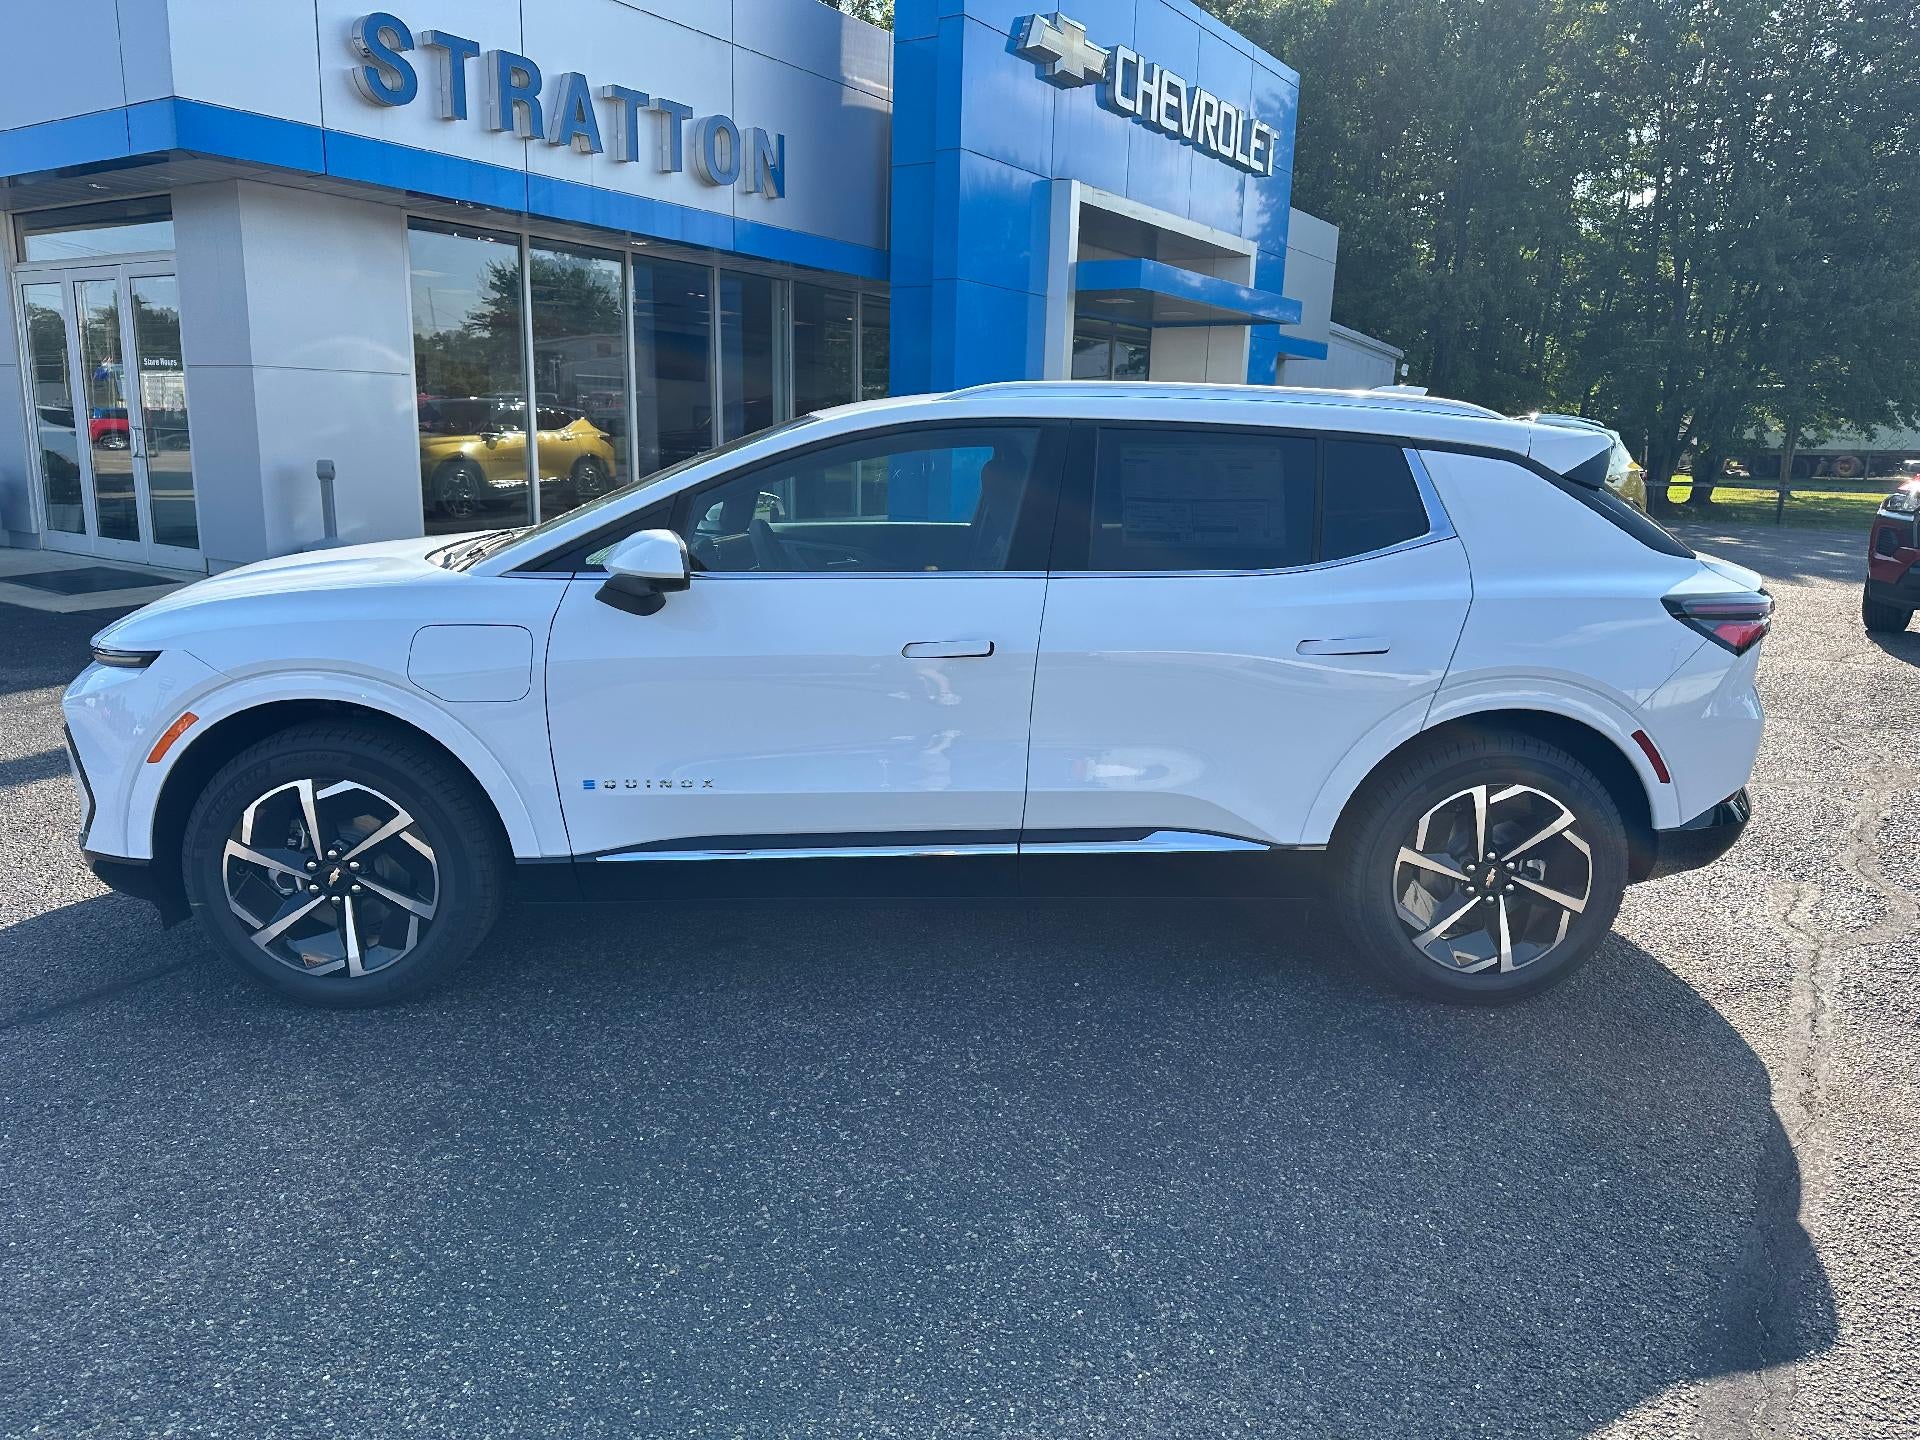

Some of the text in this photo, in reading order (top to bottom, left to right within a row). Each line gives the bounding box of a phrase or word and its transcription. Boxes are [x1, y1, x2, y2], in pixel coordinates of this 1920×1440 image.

[352, 12, 786, 199] STRATTON
[1110, 44, 1280, 177] CHEVROLET
[582, 779, 714, 790] EQUINOX
